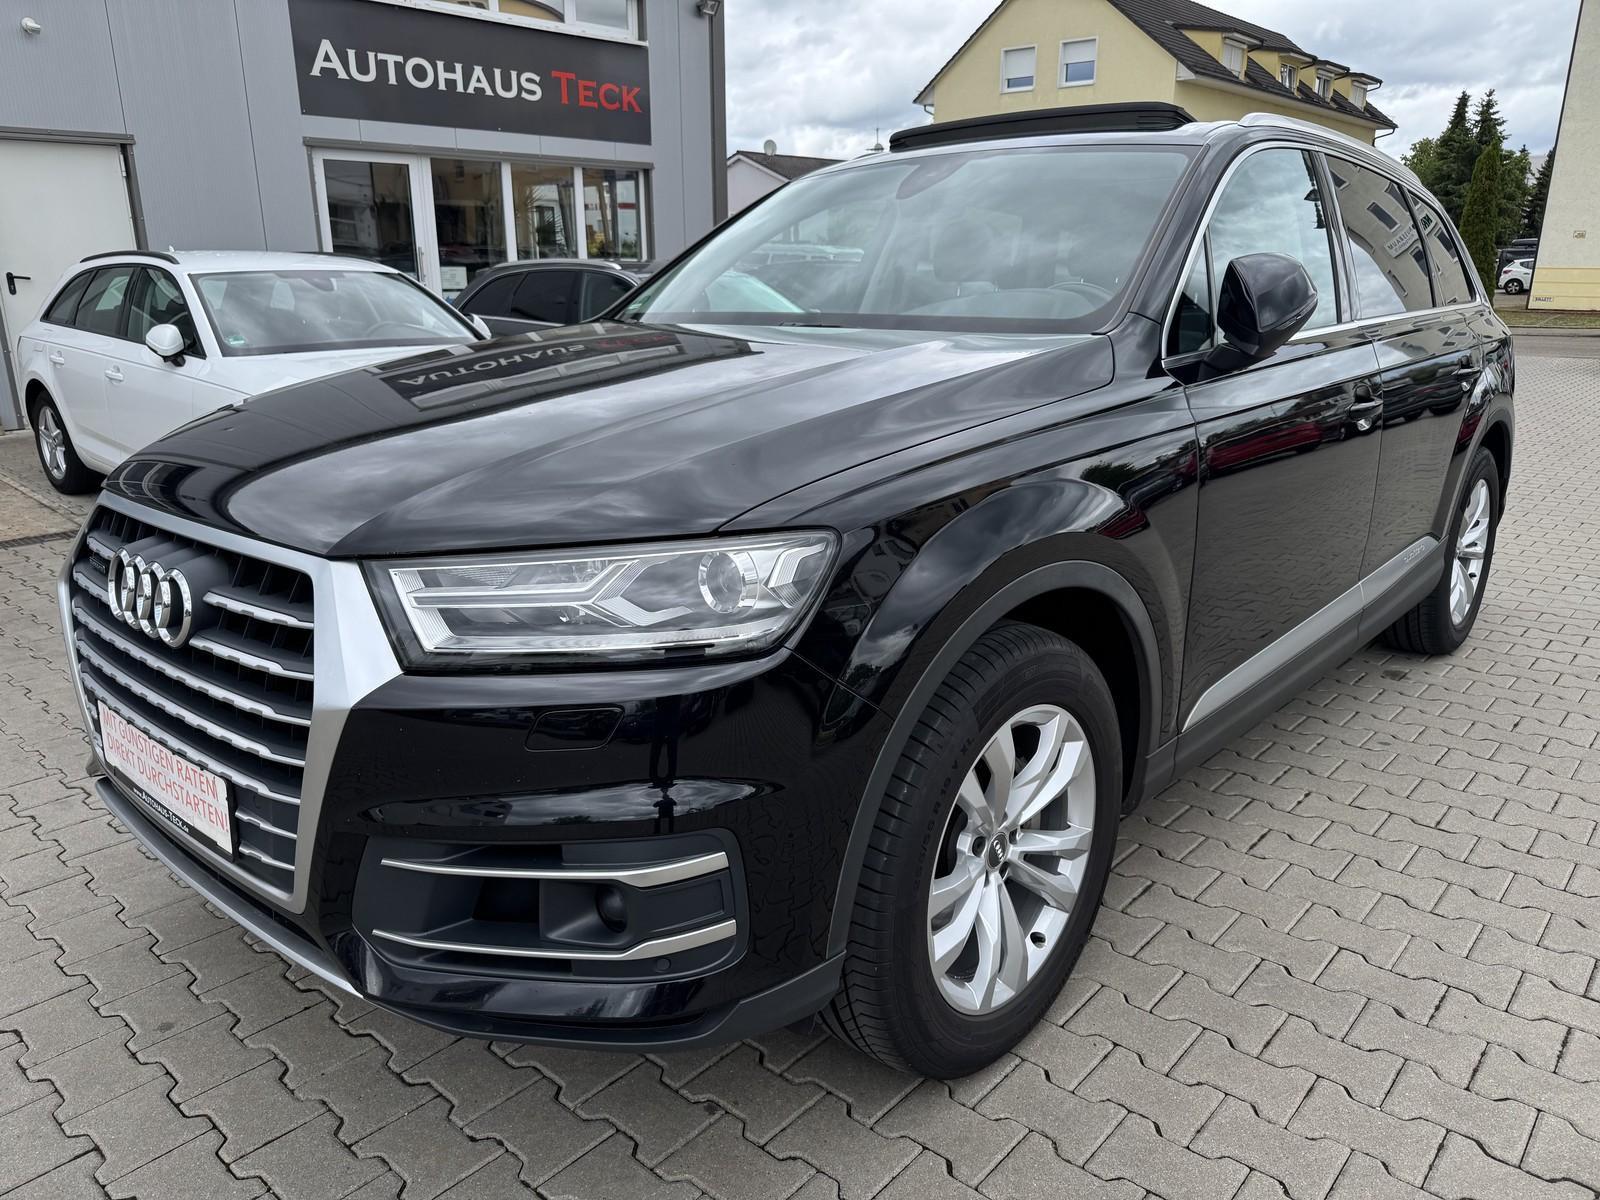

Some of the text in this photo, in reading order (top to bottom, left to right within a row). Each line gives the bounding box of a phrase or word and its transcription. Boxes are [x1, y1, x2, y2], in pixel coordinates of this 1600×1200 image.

[309, 38, 642, 114] AUTOHAUS TECK
[103, 707, 117, 732] MIT
[107, 732, 229, 833] DIREKT DURCHSTARTEN!
